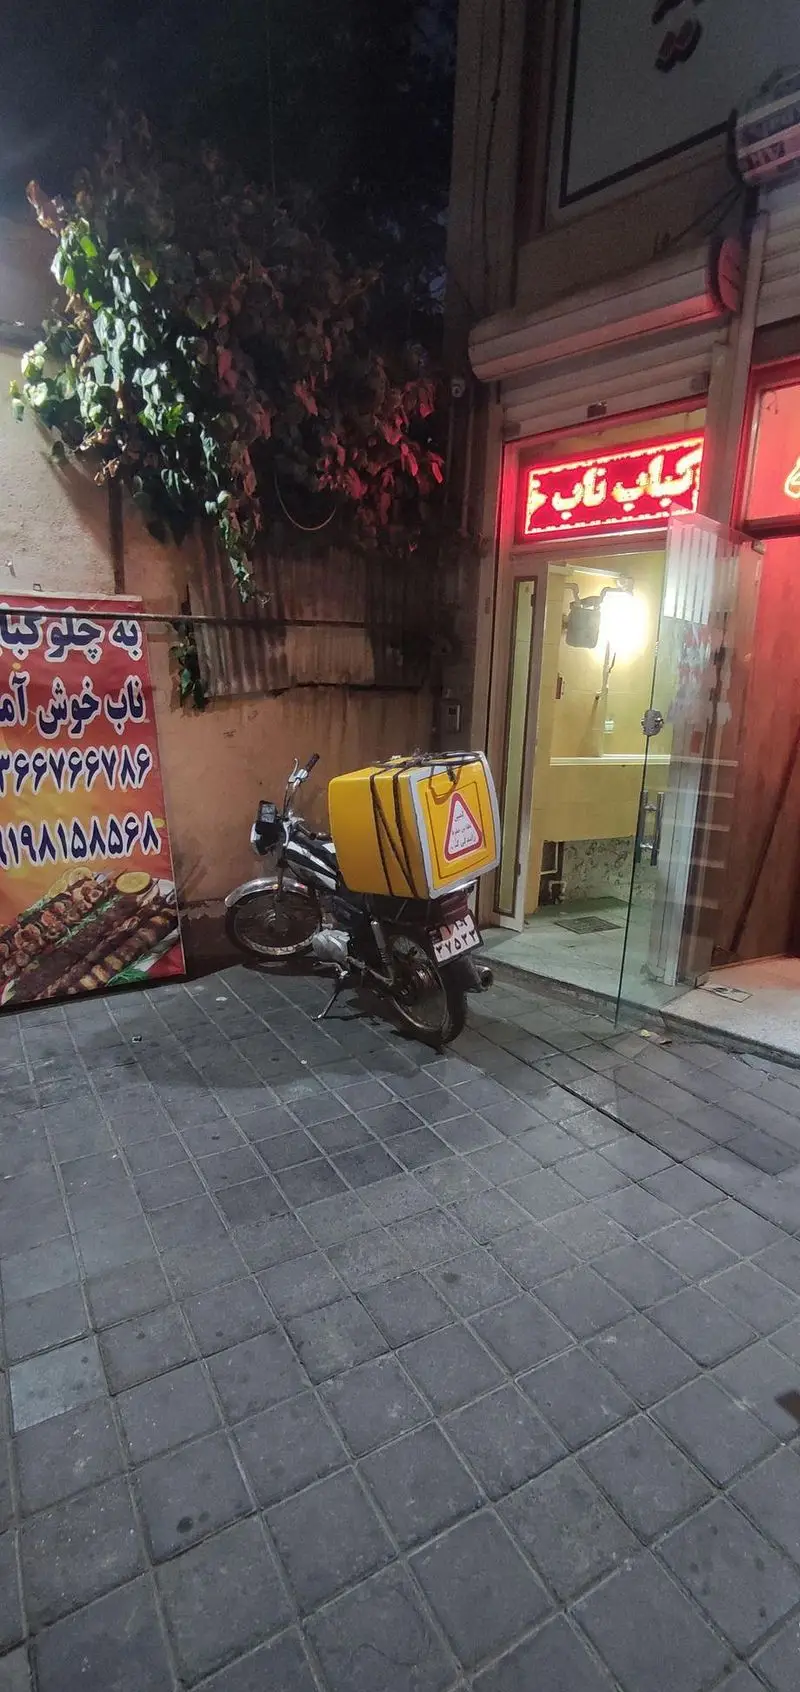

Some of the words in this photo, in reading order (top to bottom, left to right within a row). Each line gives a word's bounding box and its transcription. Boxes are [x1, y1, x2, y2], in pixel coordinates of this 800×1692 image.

[551, 467, 607, 520] ناب
[611, 447, 702, 512] کباب
[46, 608, 103, 662] چلو
[110, 616, 141, 660] به
[38, 677, 100, 738] خوش
[105, 676, 145, 733] ناب
